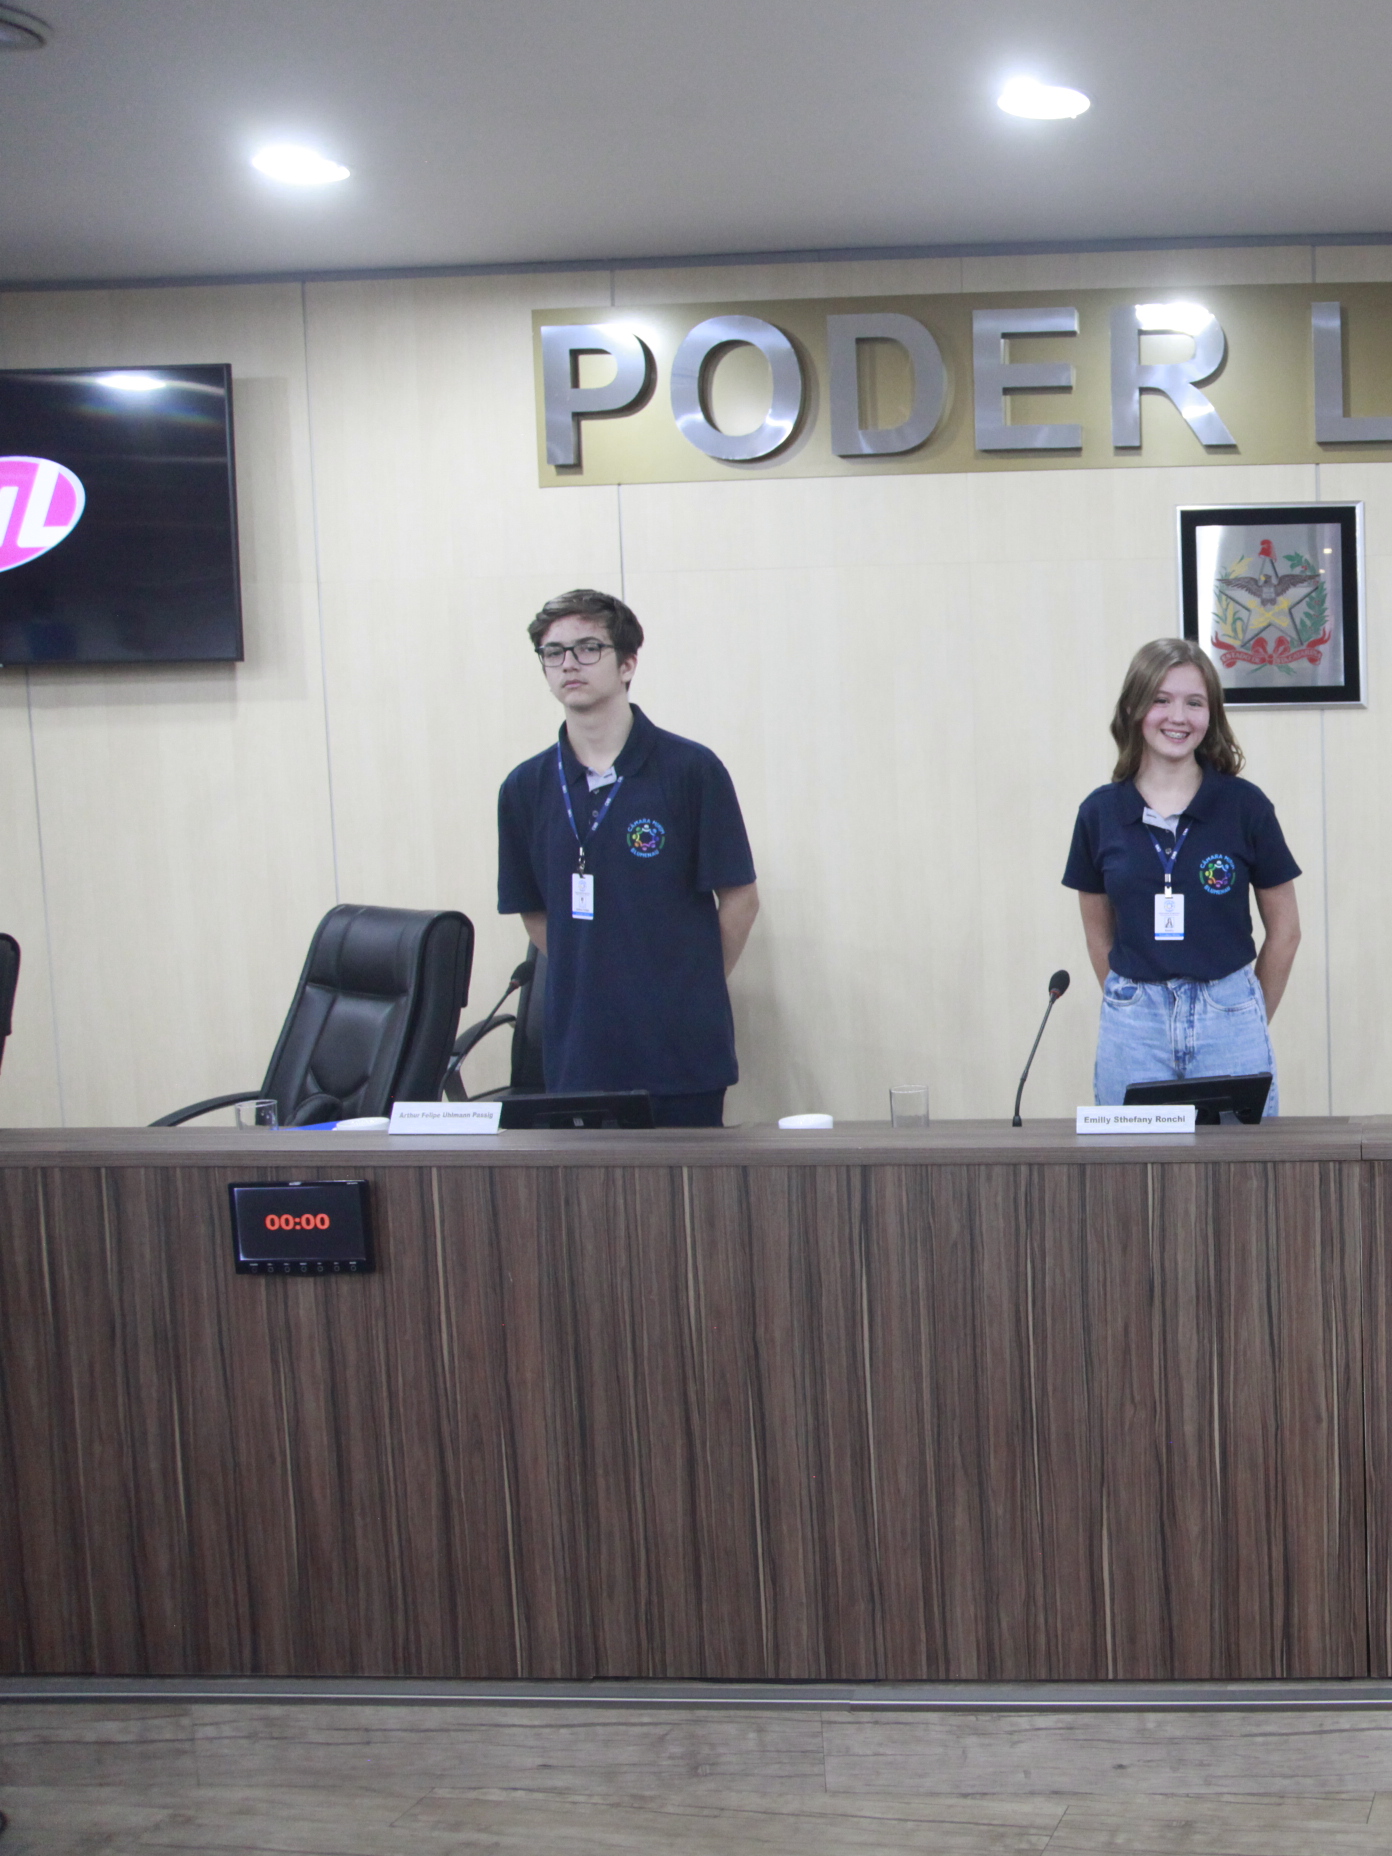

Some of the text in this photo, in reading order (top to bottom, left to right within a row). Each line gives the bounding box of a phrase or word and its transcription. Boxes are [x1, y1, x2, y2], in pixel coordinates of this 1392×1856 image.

[541, 300, 1239, 467] PODER
[421, 1111, 441, 1119] Felipe
[472, 1111, 494, 1119] Passig
[1084, 1115, 1186, 1124] Emilly Sthefany Ronchi
[264, 1213, 331, 1231] 00:00
